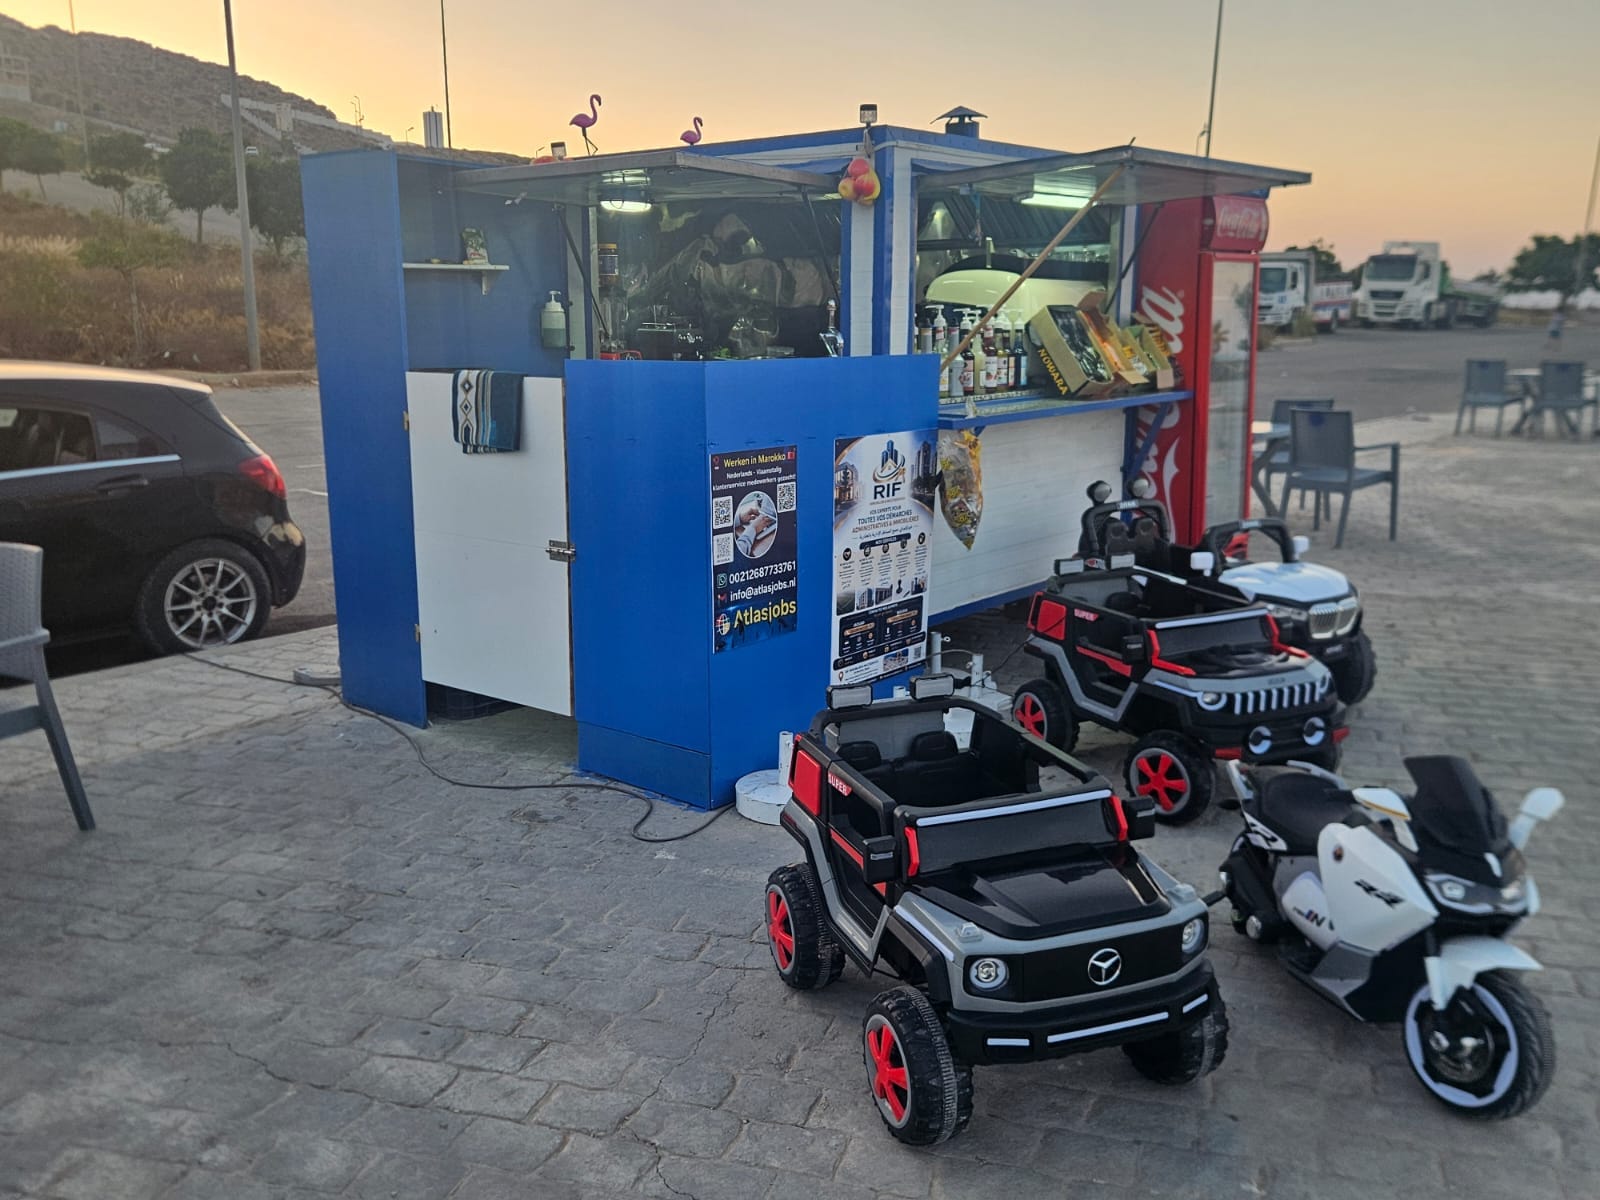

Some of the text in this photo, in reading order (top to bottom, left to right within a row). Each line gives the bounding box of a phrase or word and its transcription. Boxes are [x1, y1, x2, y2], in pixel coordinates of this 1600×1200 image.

[1037, 349, 1068, 395] NOWARA
[724, 452, 786, 468] Werken in Marokko
[726, 470, 753, 479] Nederlands
[873, 482, 902, 500] RIF
[858, 517, 876, 525] TOUTES
[729, 560, 796, 584] 00212687733761
[730, 577, 796, 602] info@atlasjobs.nl
[733, 599, 797, 628] Atlasjobs
[828, 771, 850, 796] SUPER
